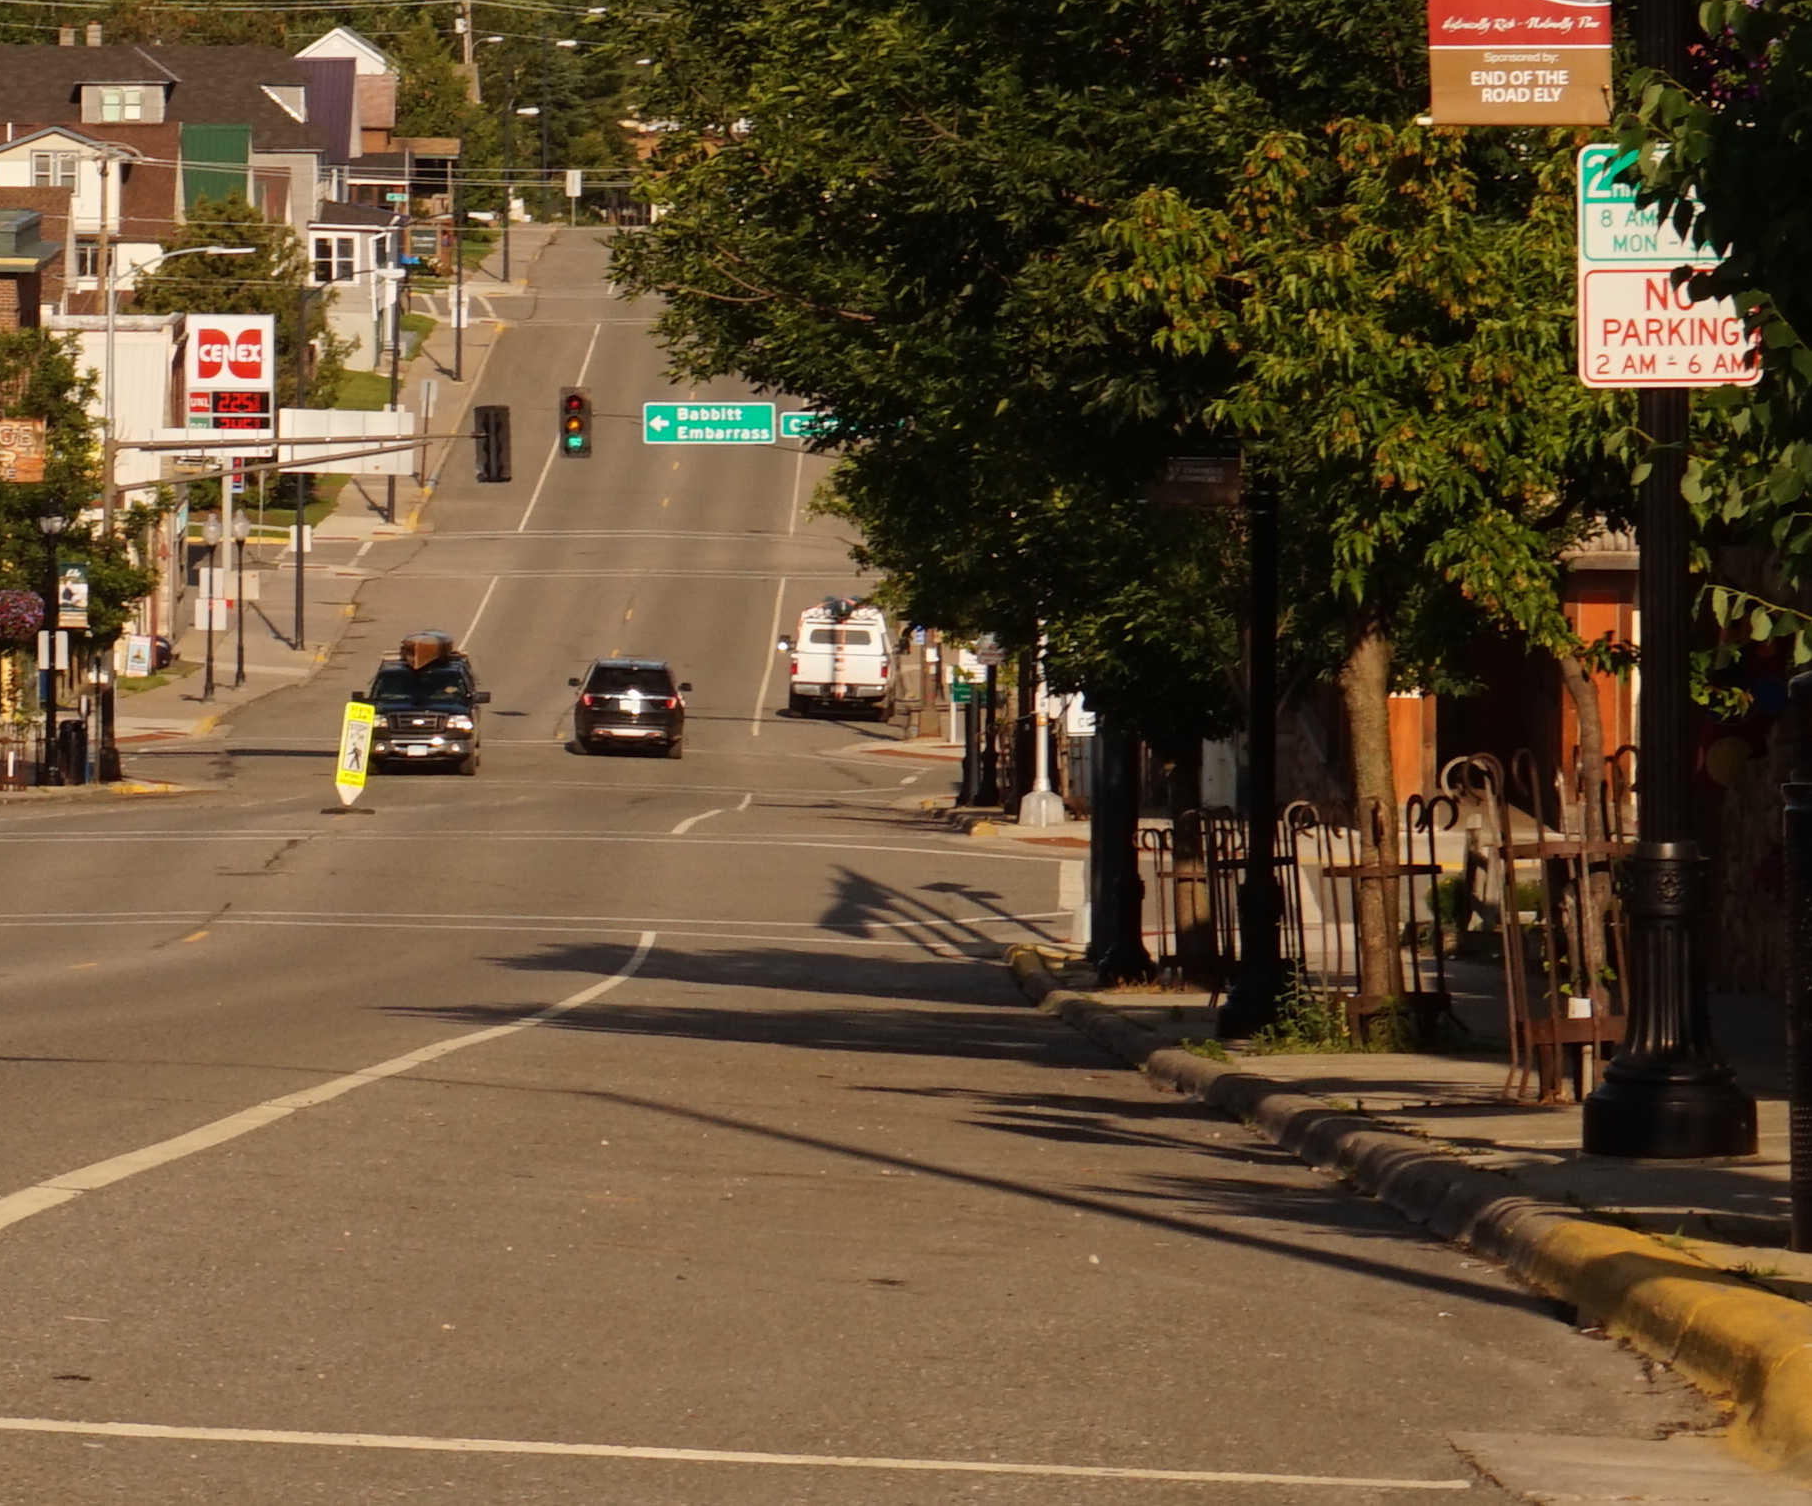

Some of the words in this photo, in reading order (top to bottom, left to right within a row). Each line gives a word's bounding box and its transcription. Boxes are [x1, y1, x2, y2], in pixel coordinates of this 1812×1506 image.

[1484, 52, 1541, 63] Sponsored
[1471, 71, 1506, 86] END
[1509, 71, 1533, 86] OF
[1534, 70, 1569, 85] THE
[1481, 88, 1530, 103] ROAD
[1534, 88, 1563, 102] ELY
[1601, 209, 1612, 228] 8
[1625, 209, 1657, 228] AM
[1613, 234, 1657, 253] MON
[1603, 319, 1740, 346] PARKING
[199, 343, 262, 363] CENEX
[1596, 355, 1610, 374] 2
[1622, 355, 1656, 374] AM
[1689, 355, 1702, 373] 6
[1713, 354, 1746, 373] AM
[677, 408, 743, 421] Babbitt
[677, 426, 770, 440] Embarrass
